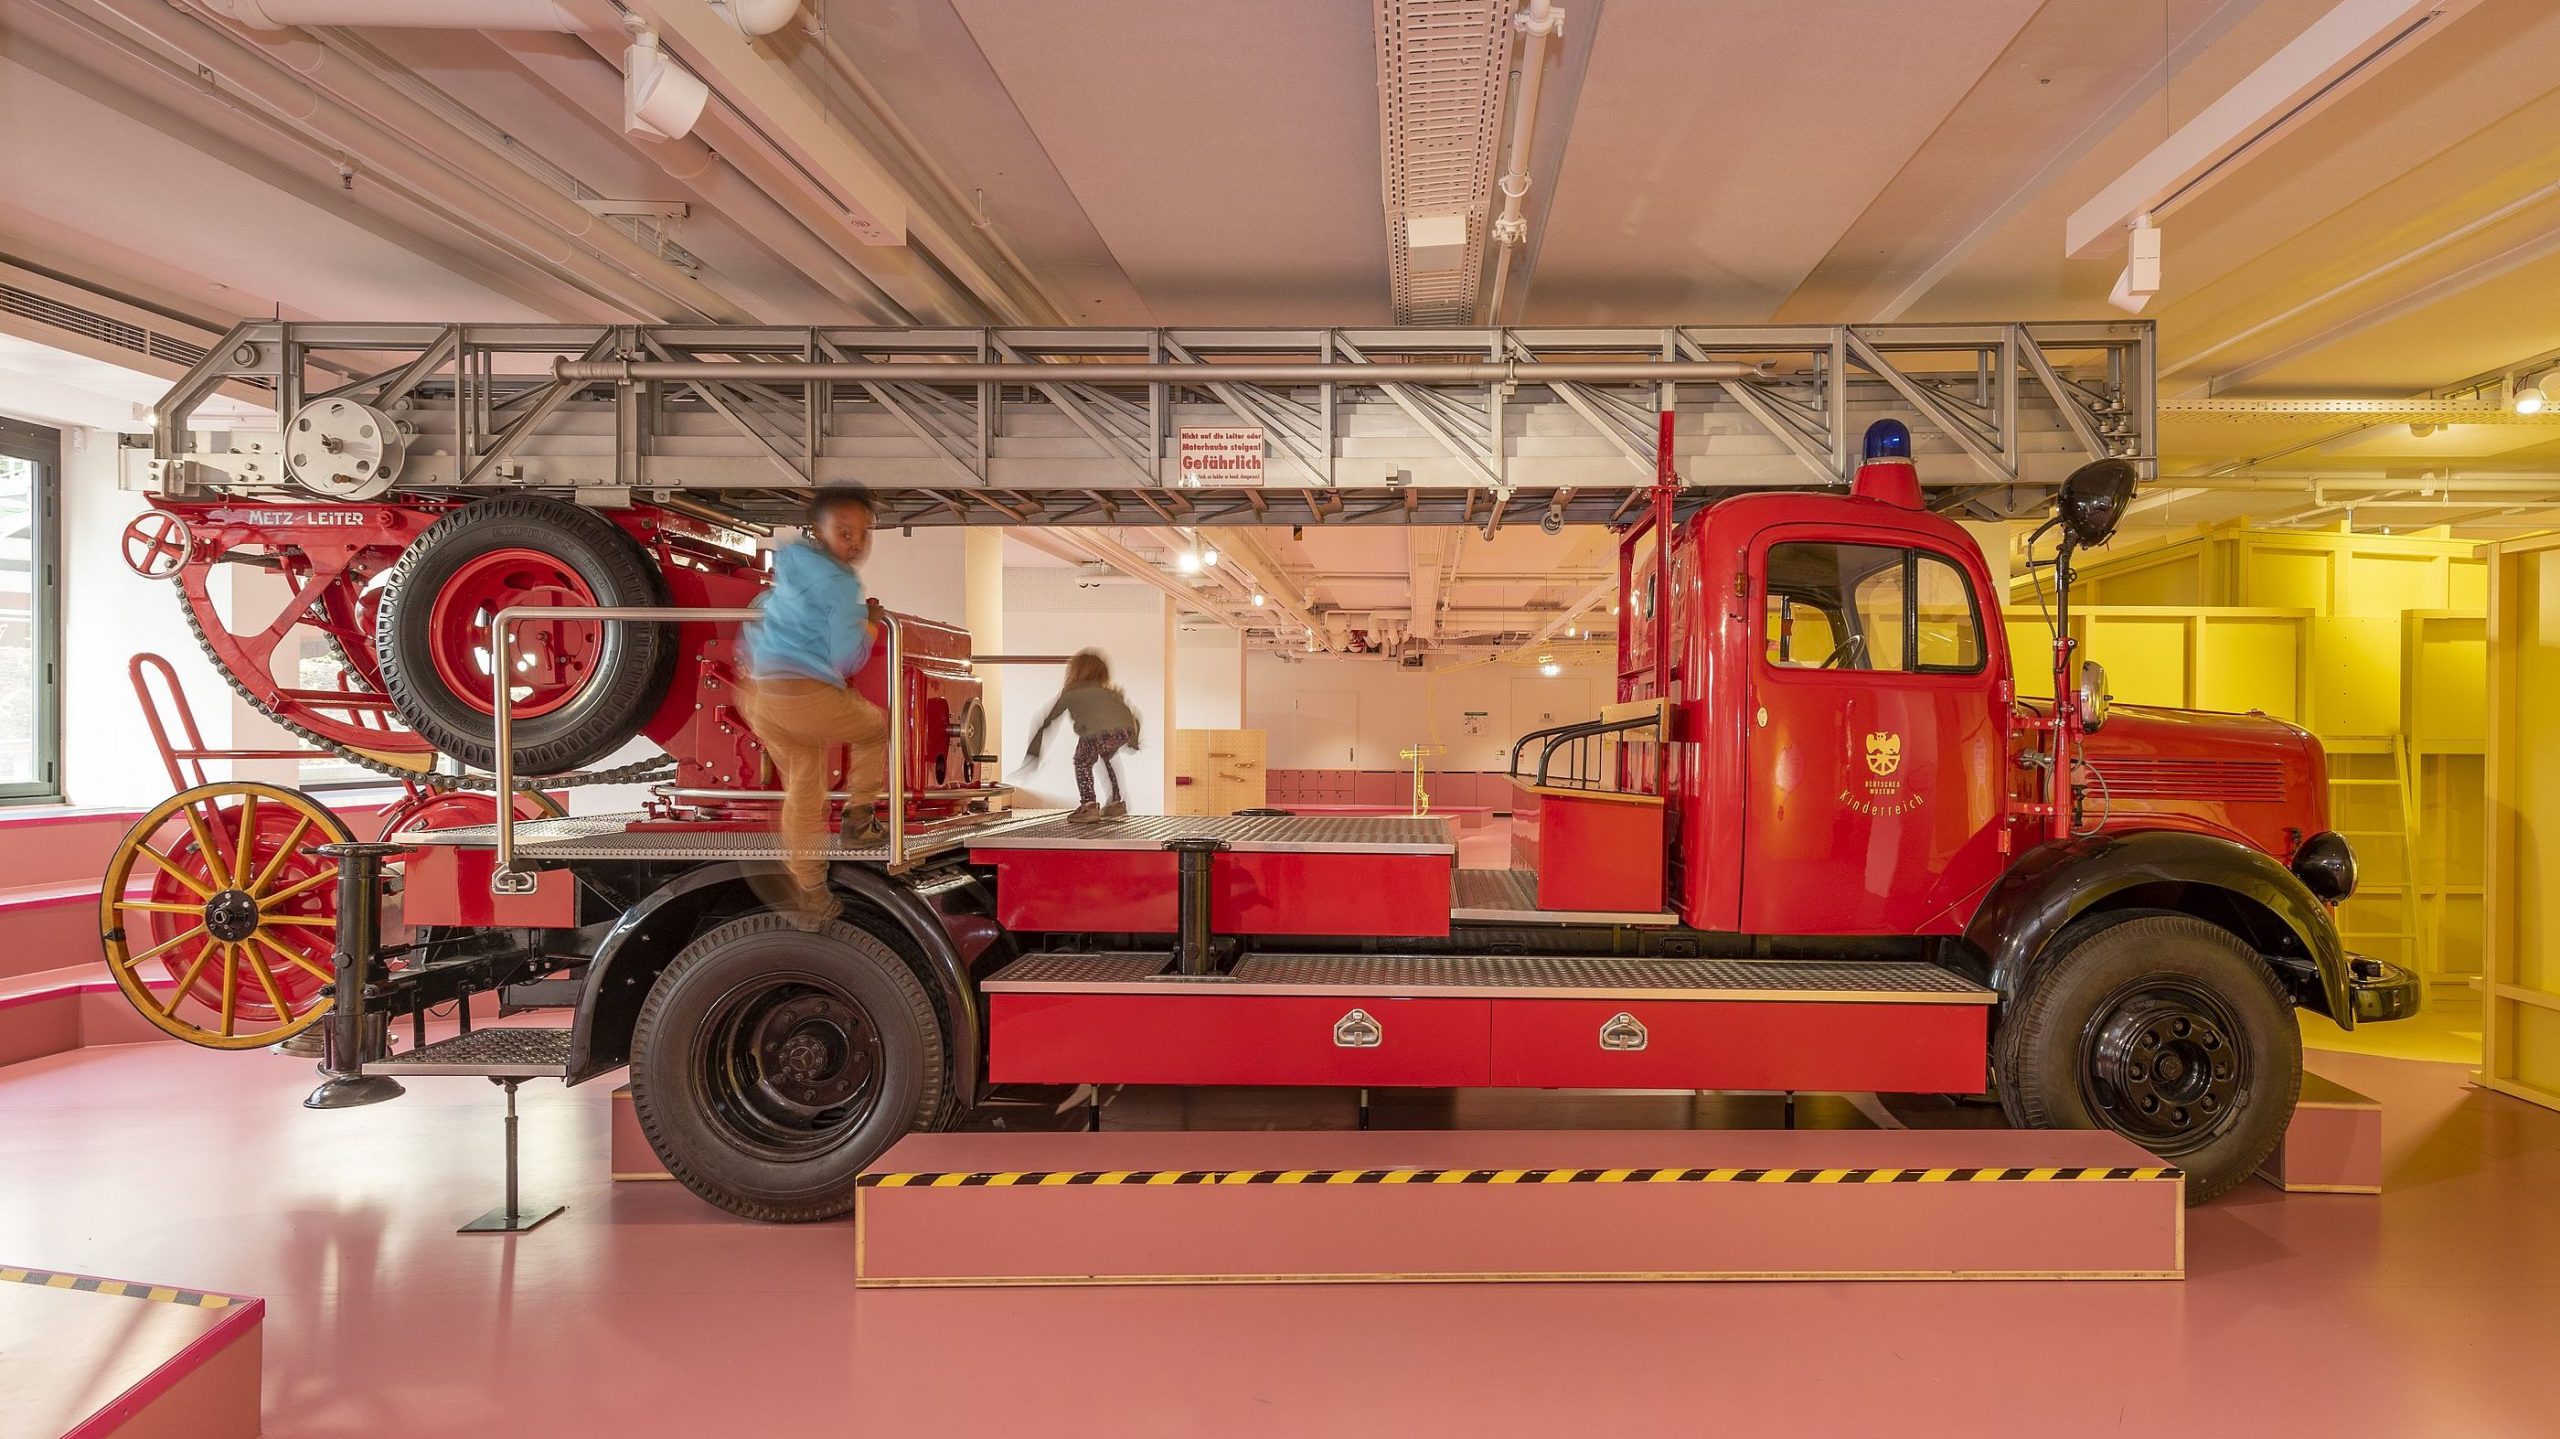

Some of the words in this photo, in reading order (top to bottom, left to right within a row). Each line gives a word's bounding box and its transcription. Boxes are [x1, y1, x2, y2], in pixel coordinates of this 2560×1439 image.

[1231, 443, 1261, 452] steigen!
[1182, 455, 1261, 469] Gefährlich
[1839, 789, 1924, 816] Kinderreich
